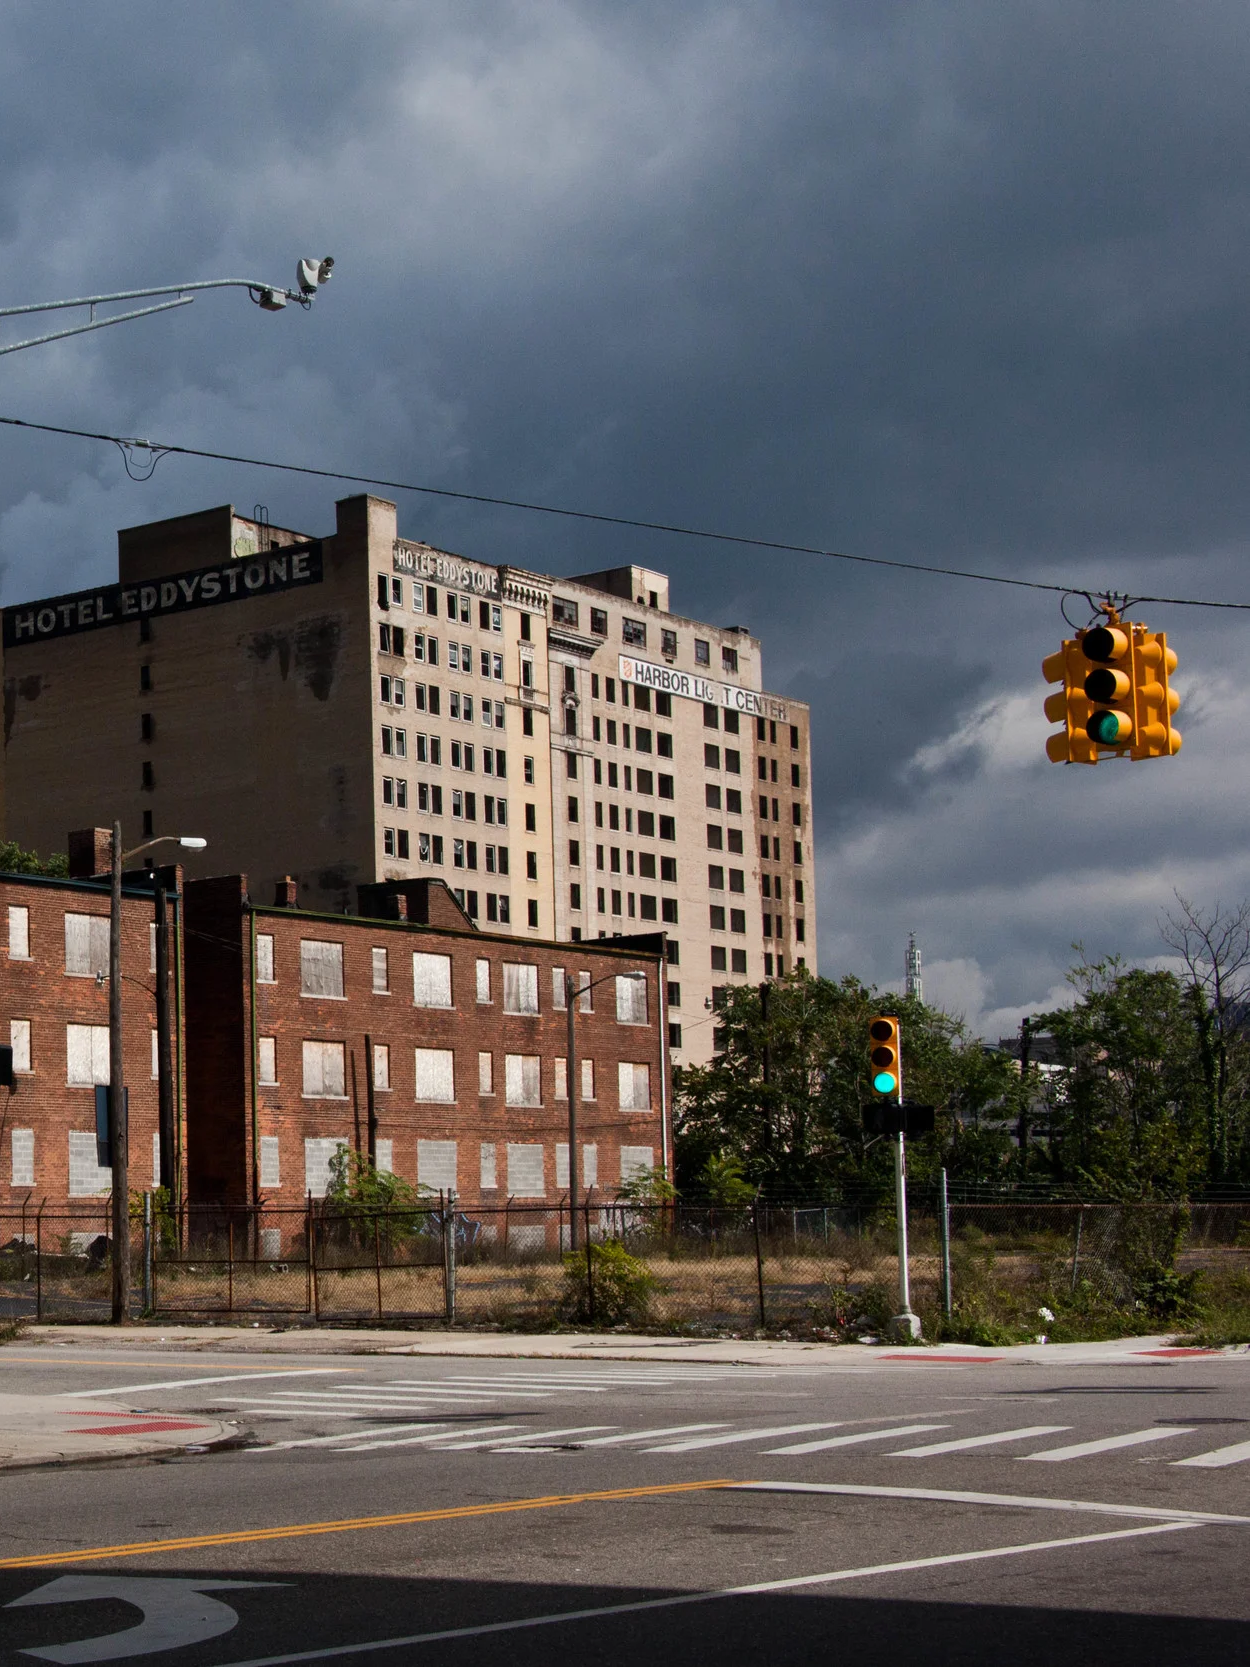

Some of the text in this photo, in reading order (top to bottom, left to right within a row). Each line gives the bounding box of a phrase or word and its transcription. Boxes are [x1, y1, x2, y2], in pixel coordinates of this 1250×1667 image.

[398, 547, 498, 593] HOTEL EDDYSTONE
[14, 551, 311, 639] HOTEL EDDYSTONE
[635, 662, 690, 695] HARBOR
[694, 679, 732, 706] LIGT
